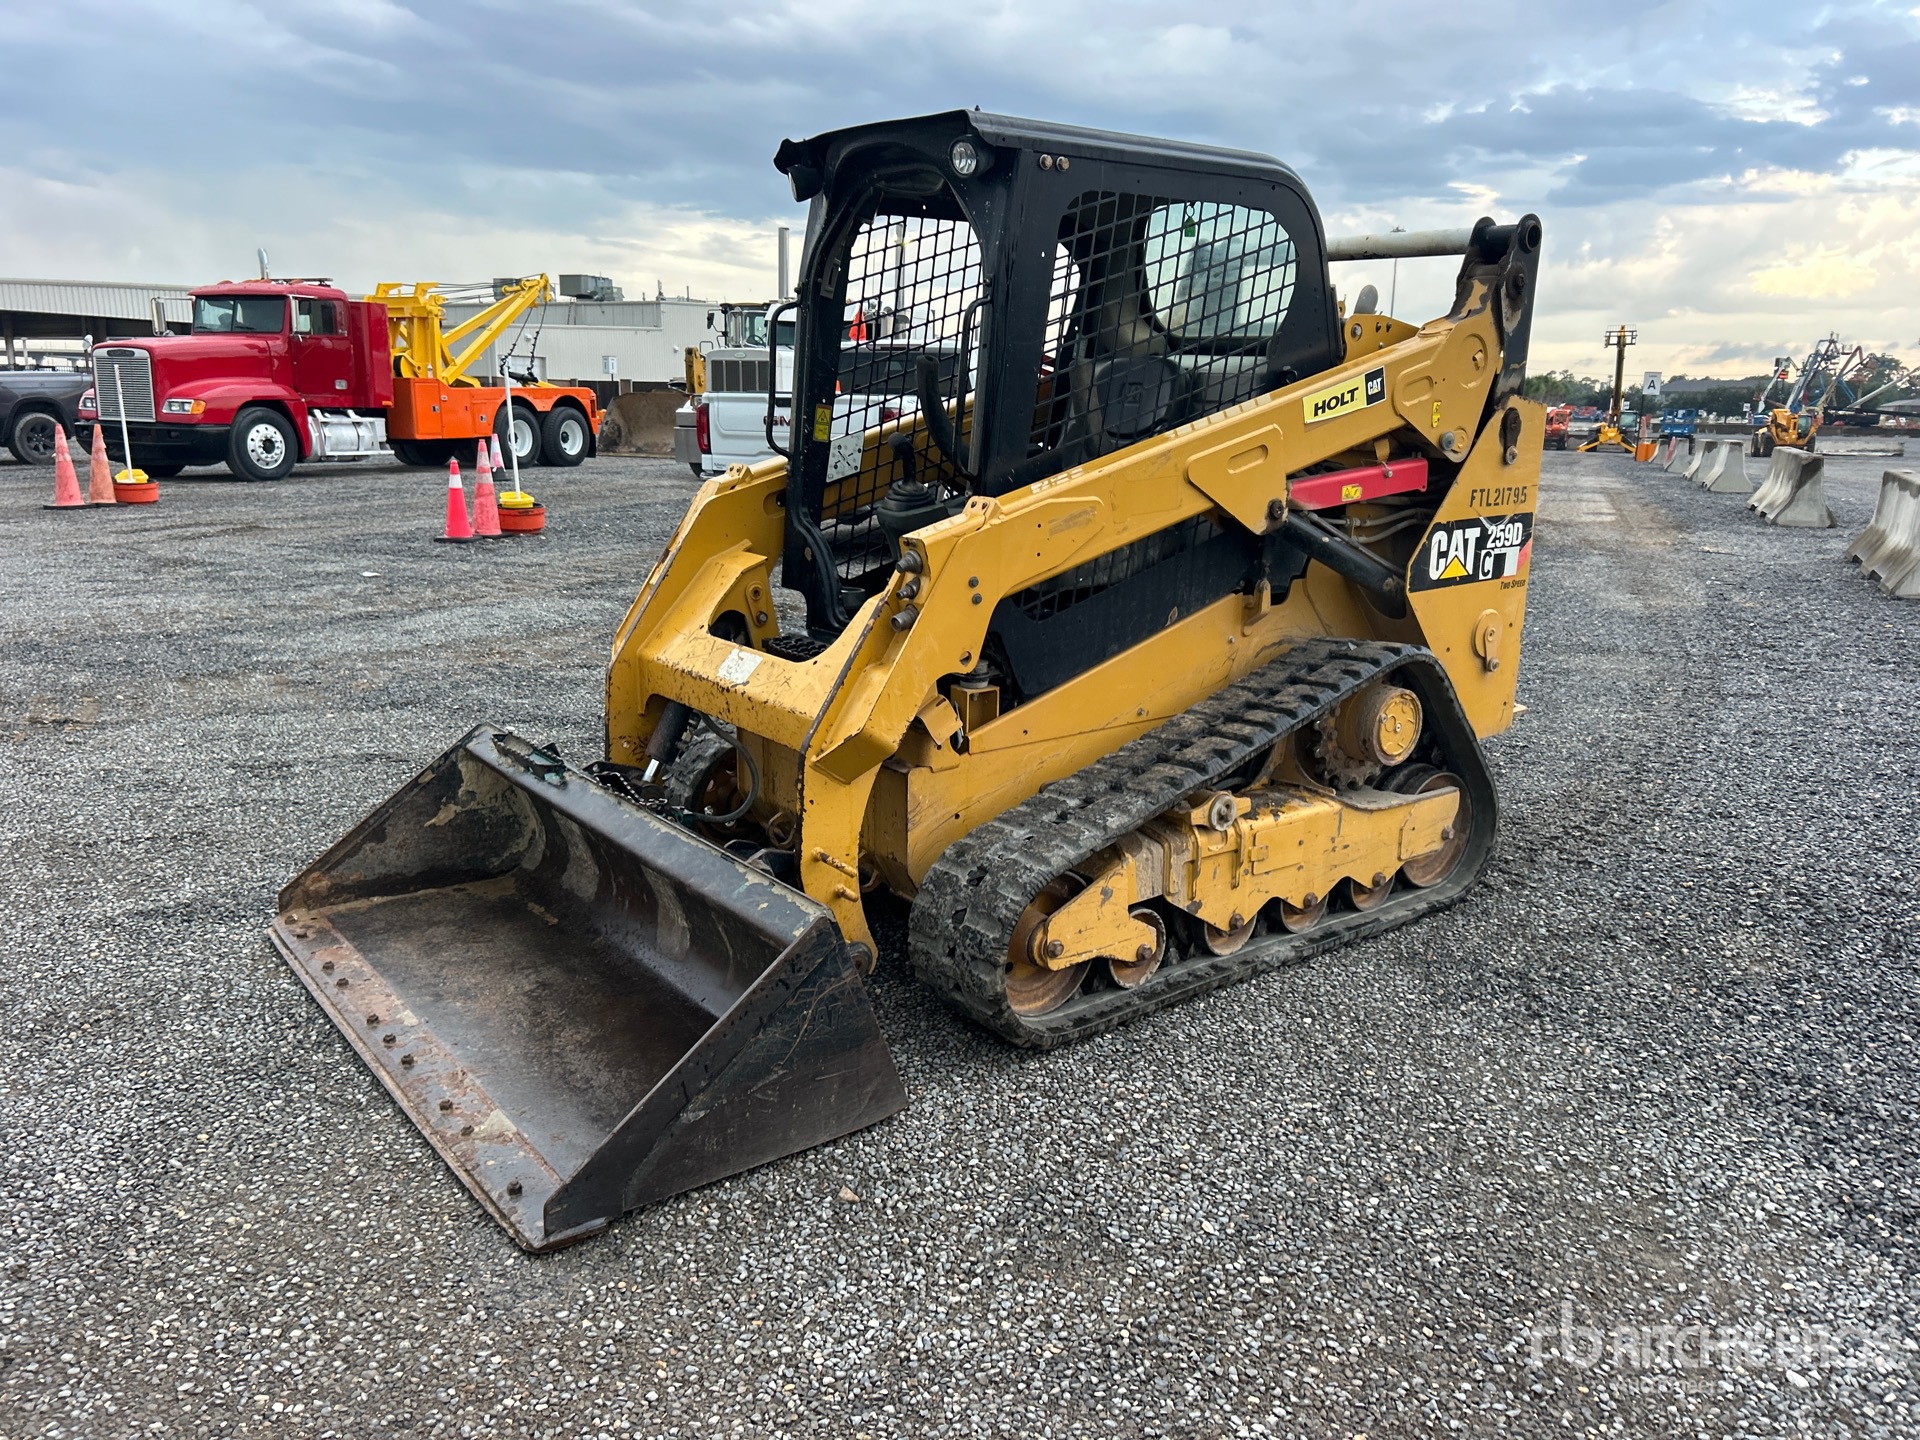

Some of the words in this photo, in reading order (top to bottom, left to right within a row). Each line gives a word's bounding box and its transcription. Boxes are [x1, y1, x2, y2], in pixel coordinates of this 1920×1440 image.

[1647, 379, 1656, 390] A
[1313, 386, 1359, 417] HOLT
[1367, 377, 1383, 396] CAT
[763, 415, 791, 426] GM
[1469, 486, 1528, 508] FTL21795
[1429, 526, 1481, 581] CAT
[1486, 522, 1524, 548] 259D
